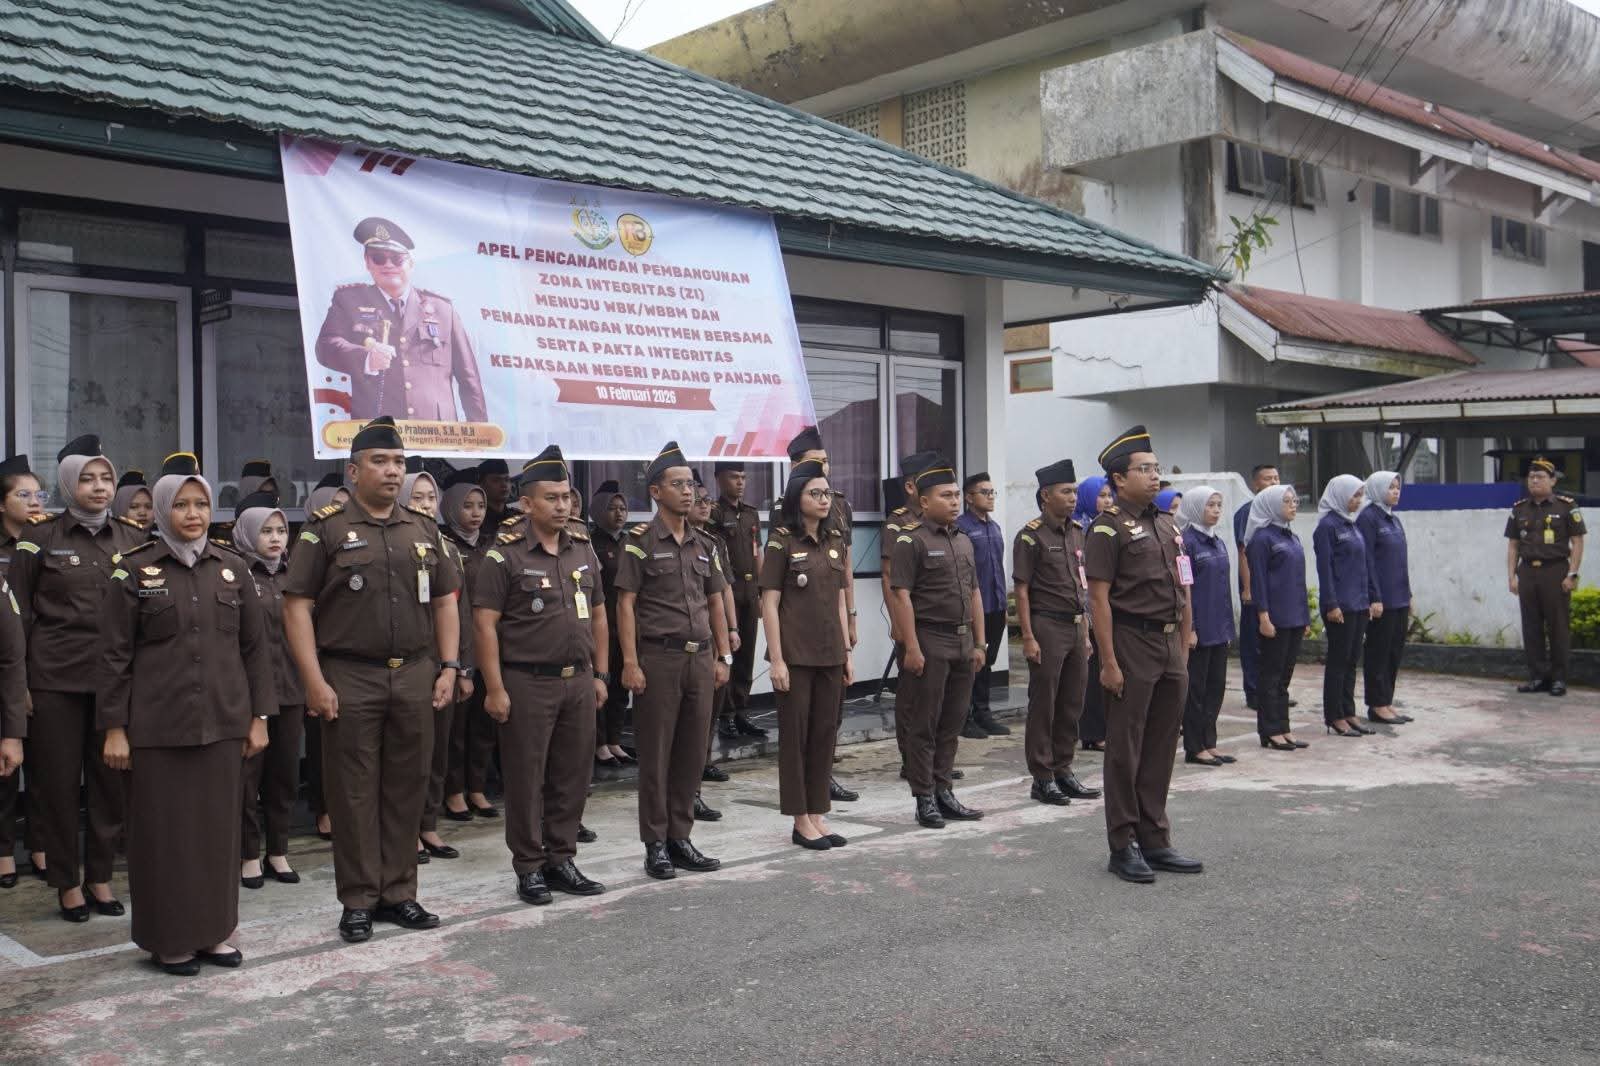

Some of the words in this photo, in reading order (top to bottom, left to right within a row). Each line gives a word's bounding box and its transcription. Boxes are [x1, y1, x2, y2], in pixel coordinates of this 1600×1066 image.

[477, 241, 520, 259] APEL
[524, 248, 639, 274] PENCANANGAN
[642, 263, 750, 284] PEMBANGUNAN
[538, 273, 582, 289] ZONA
[585, 278, 677, 298] INTEGRITAS
[679, 286, 705, 302] (ZI)
[534, 294, 600, 311] MENUJU
[603, 301, 688, 319] WBK/WBBM
[691, 308, 720, 321] DAN
[480, 308, 622, 334] PENANDATANGAN
[625, 323, 701, 341] KOMITMEN
[704, 330, 773, 344] BERSAMA
[536, 336, 589, 353] SERTA
[592, 342, 646, 357] PAKTA
[647, 346, 734, 363] INTEGRITAS
[490, 354, 589, 374] KEJAKSAAN
[592, 363, 649, 379] NEGERI
[651, 367, 710, 383] PADANG
[713, 371, 782, 385] PANJANG
[595, 385, 606, 399] 10
[609, 386, 650, 402] Februari
[652, 389, 677, 404] 2026
[404, 424, 441, 436] Prabowo,
[410, 437, 433, 445] Negeri
[435, 437, 461, 445] Padang
